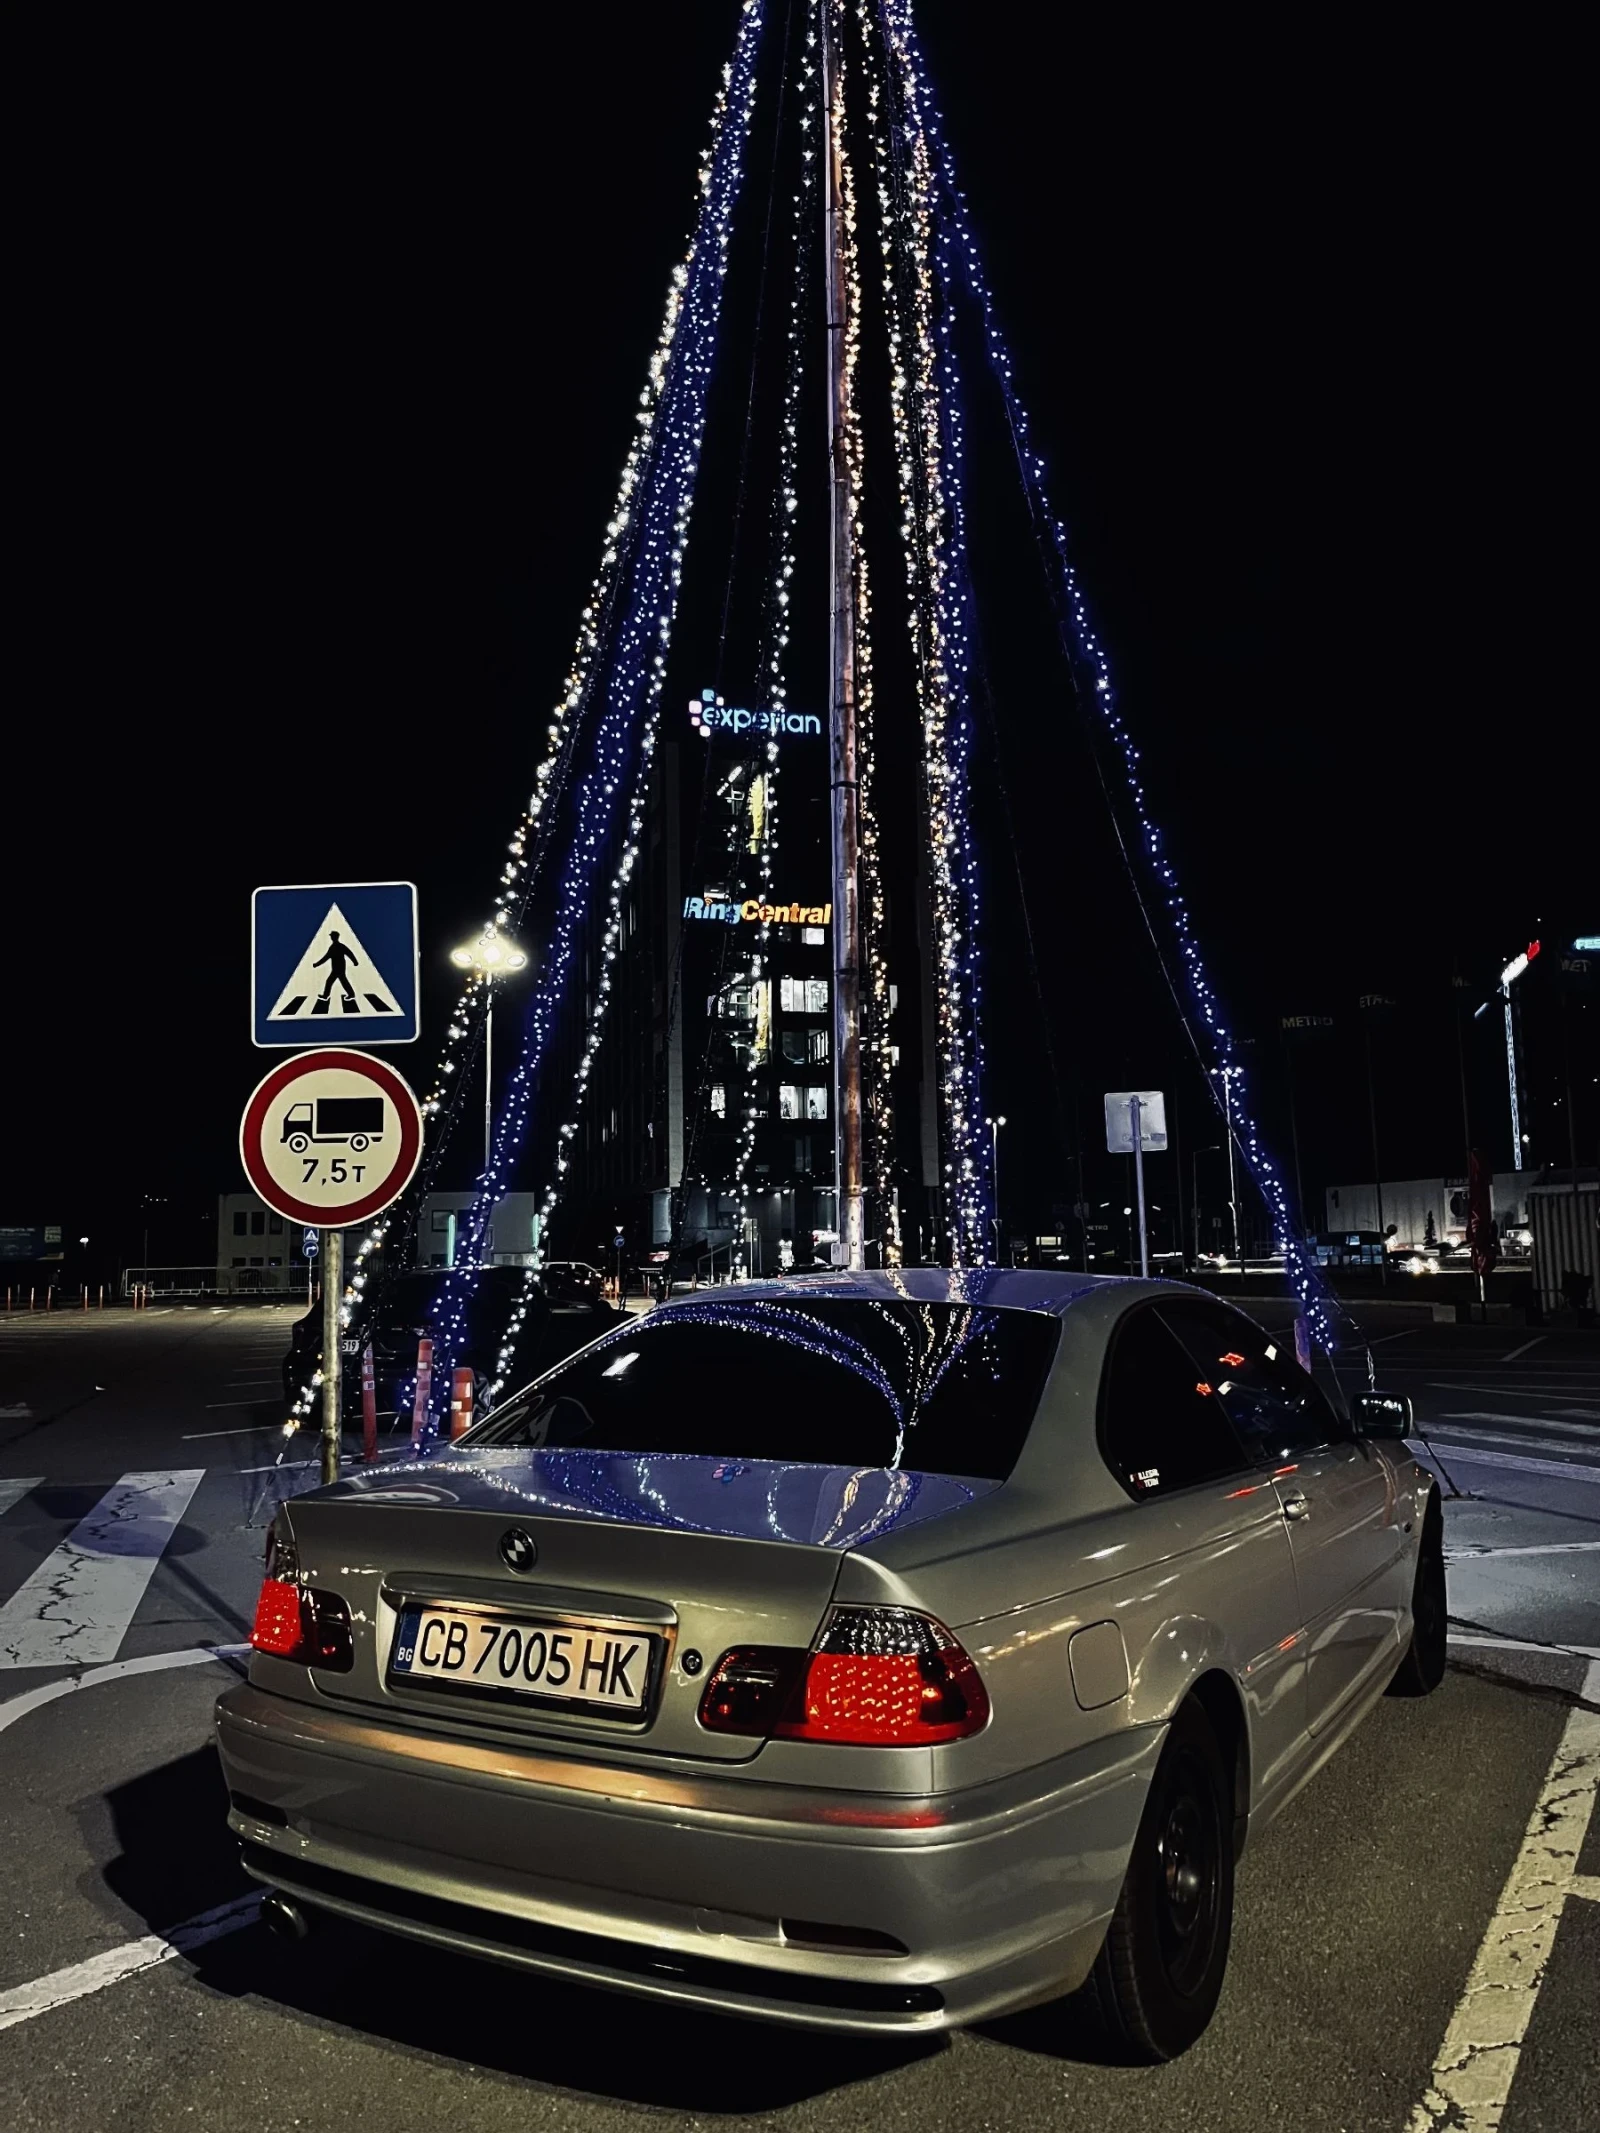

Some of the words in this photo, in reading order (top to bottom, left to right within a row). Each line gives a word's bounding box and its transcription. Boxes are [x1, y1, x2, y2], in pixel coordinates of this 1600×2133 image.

[702, 706, 822, 735] experian
[683, 897, 832, 925] RingCentral
[397, 1646, 413, 1662] BG
[419, 1618, 468, 1670] CB
[472, 1625, 573, 1686] 7005
[579, 1638, 640, 1698] HK
